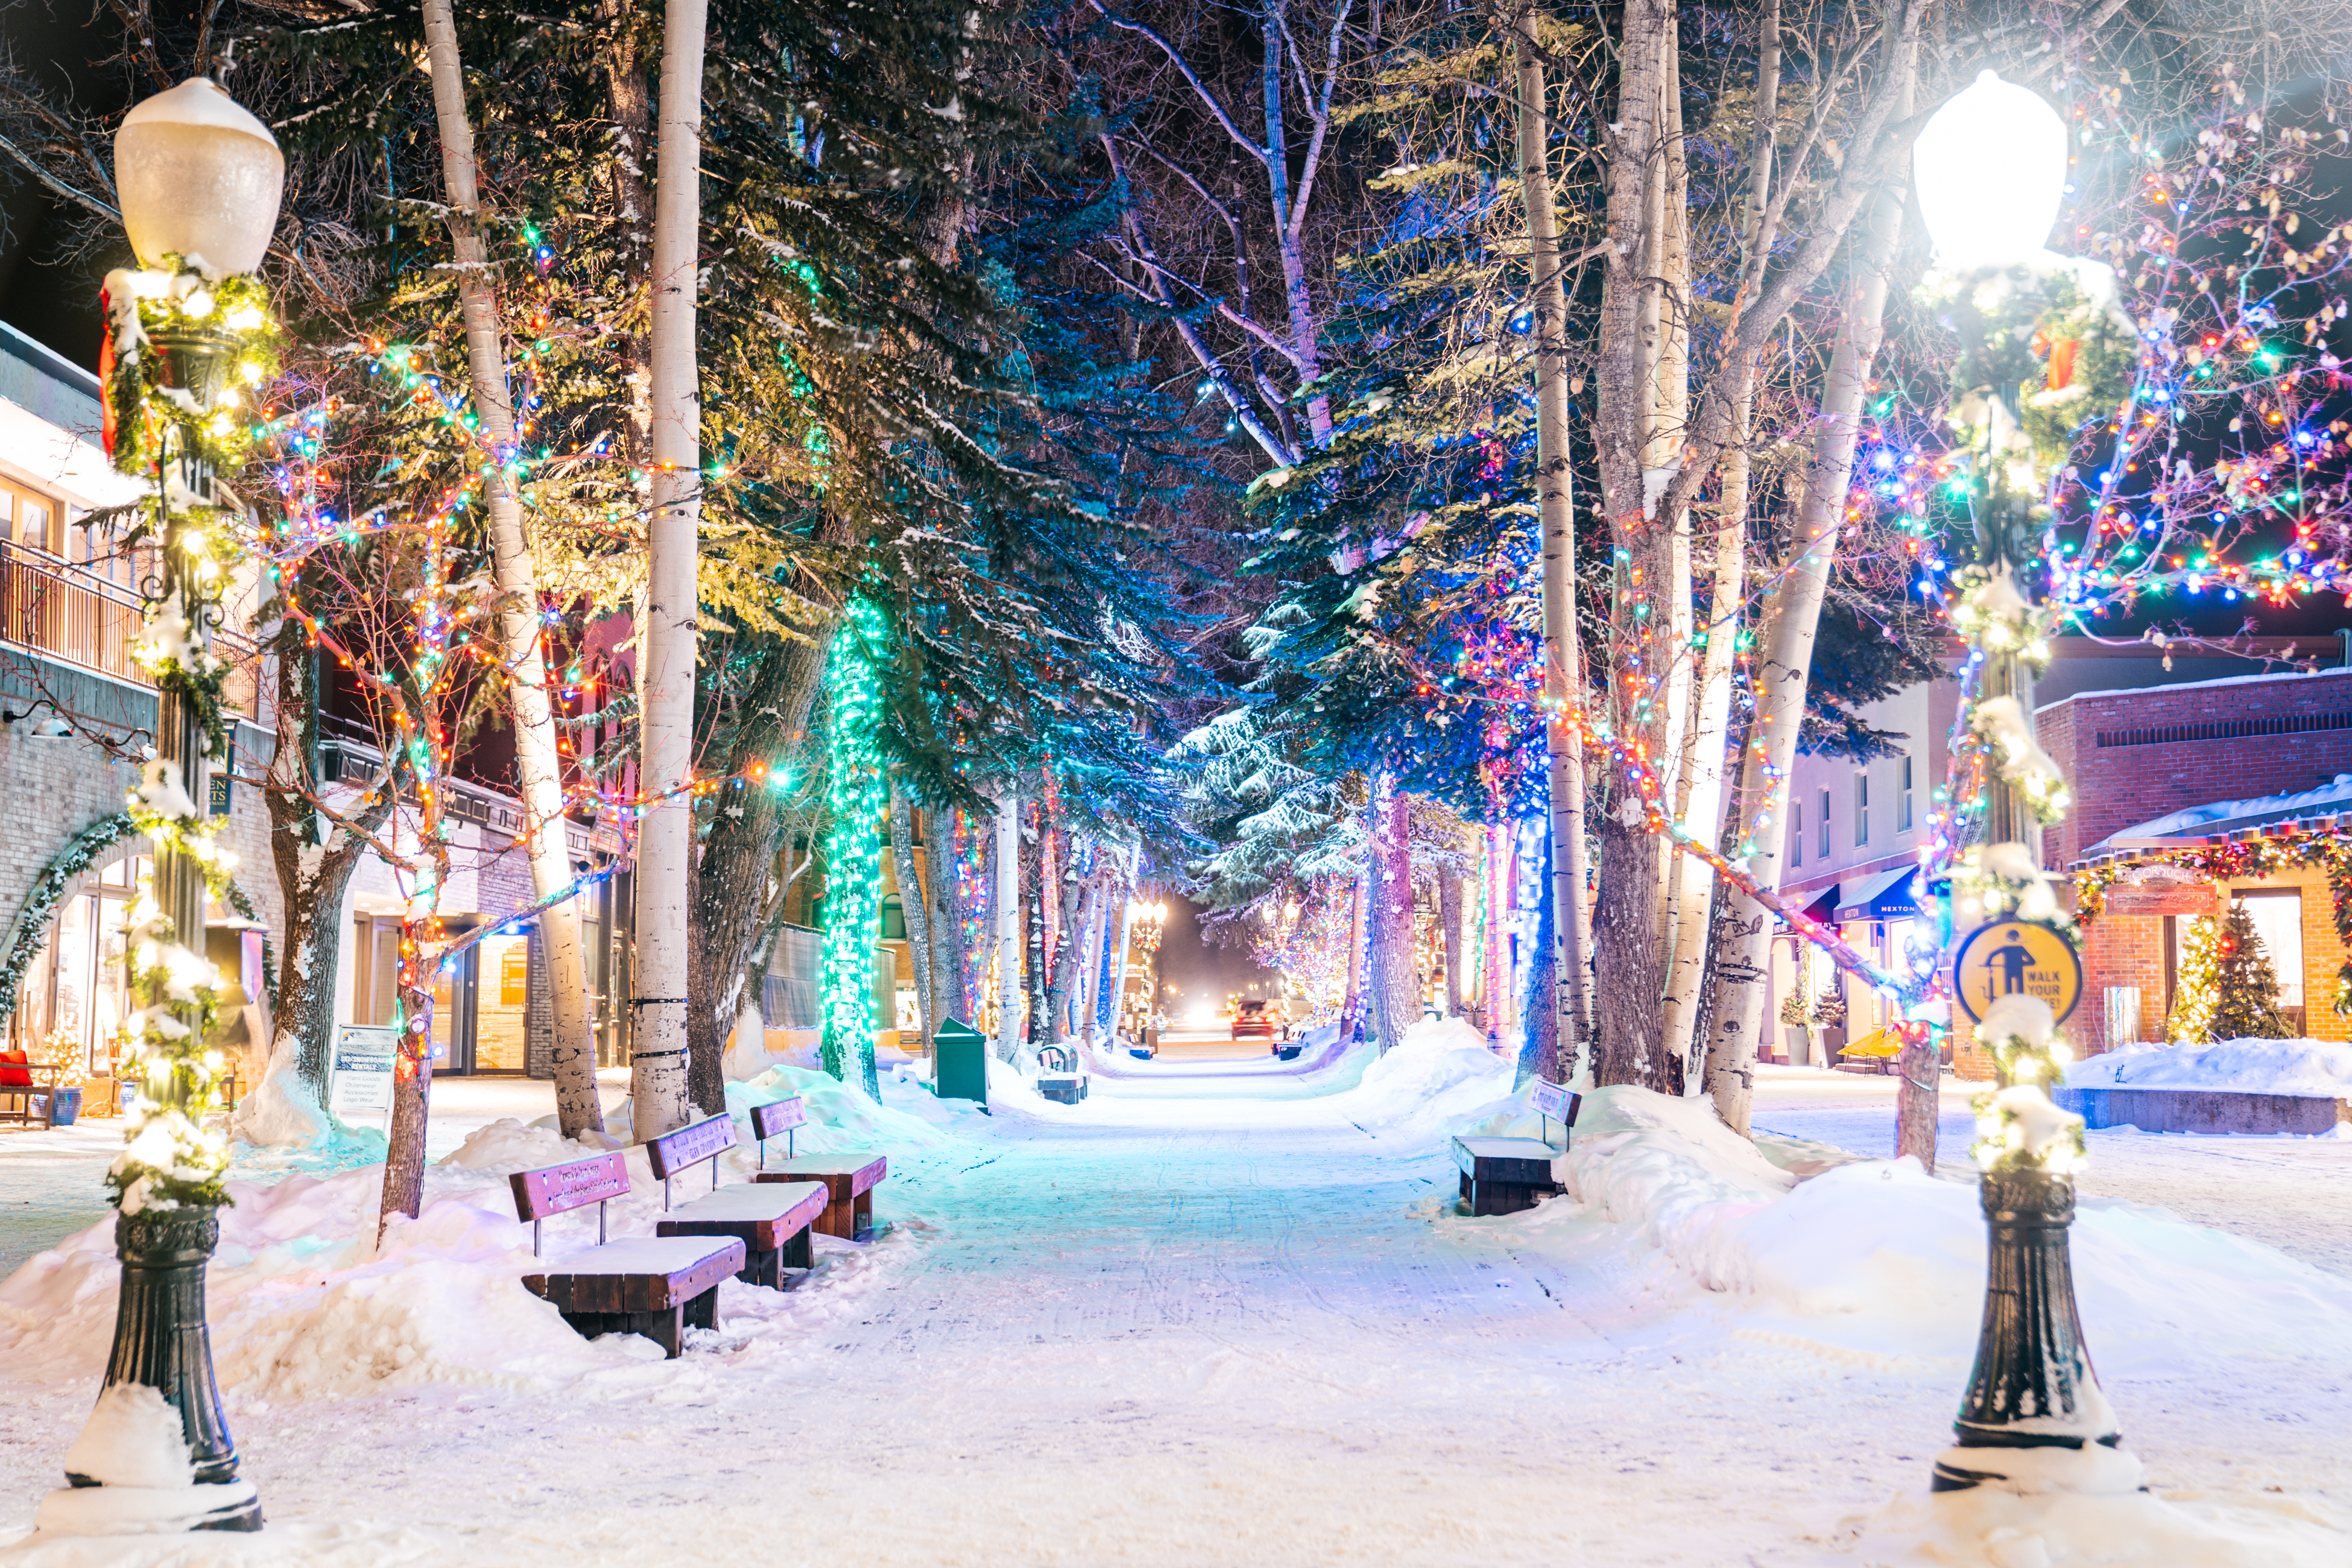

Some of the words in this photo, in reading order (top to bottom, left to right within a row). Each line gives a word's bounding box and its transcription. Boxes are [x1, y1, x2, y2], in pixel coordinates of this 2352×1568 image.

[2132, 865, 2189, 882] GORSUCH
[1844, 908, 1859, 919] HEXTON
[2026, 971, 2060, 982] WALK
[2027, 984, 2060, 996] YOUR
